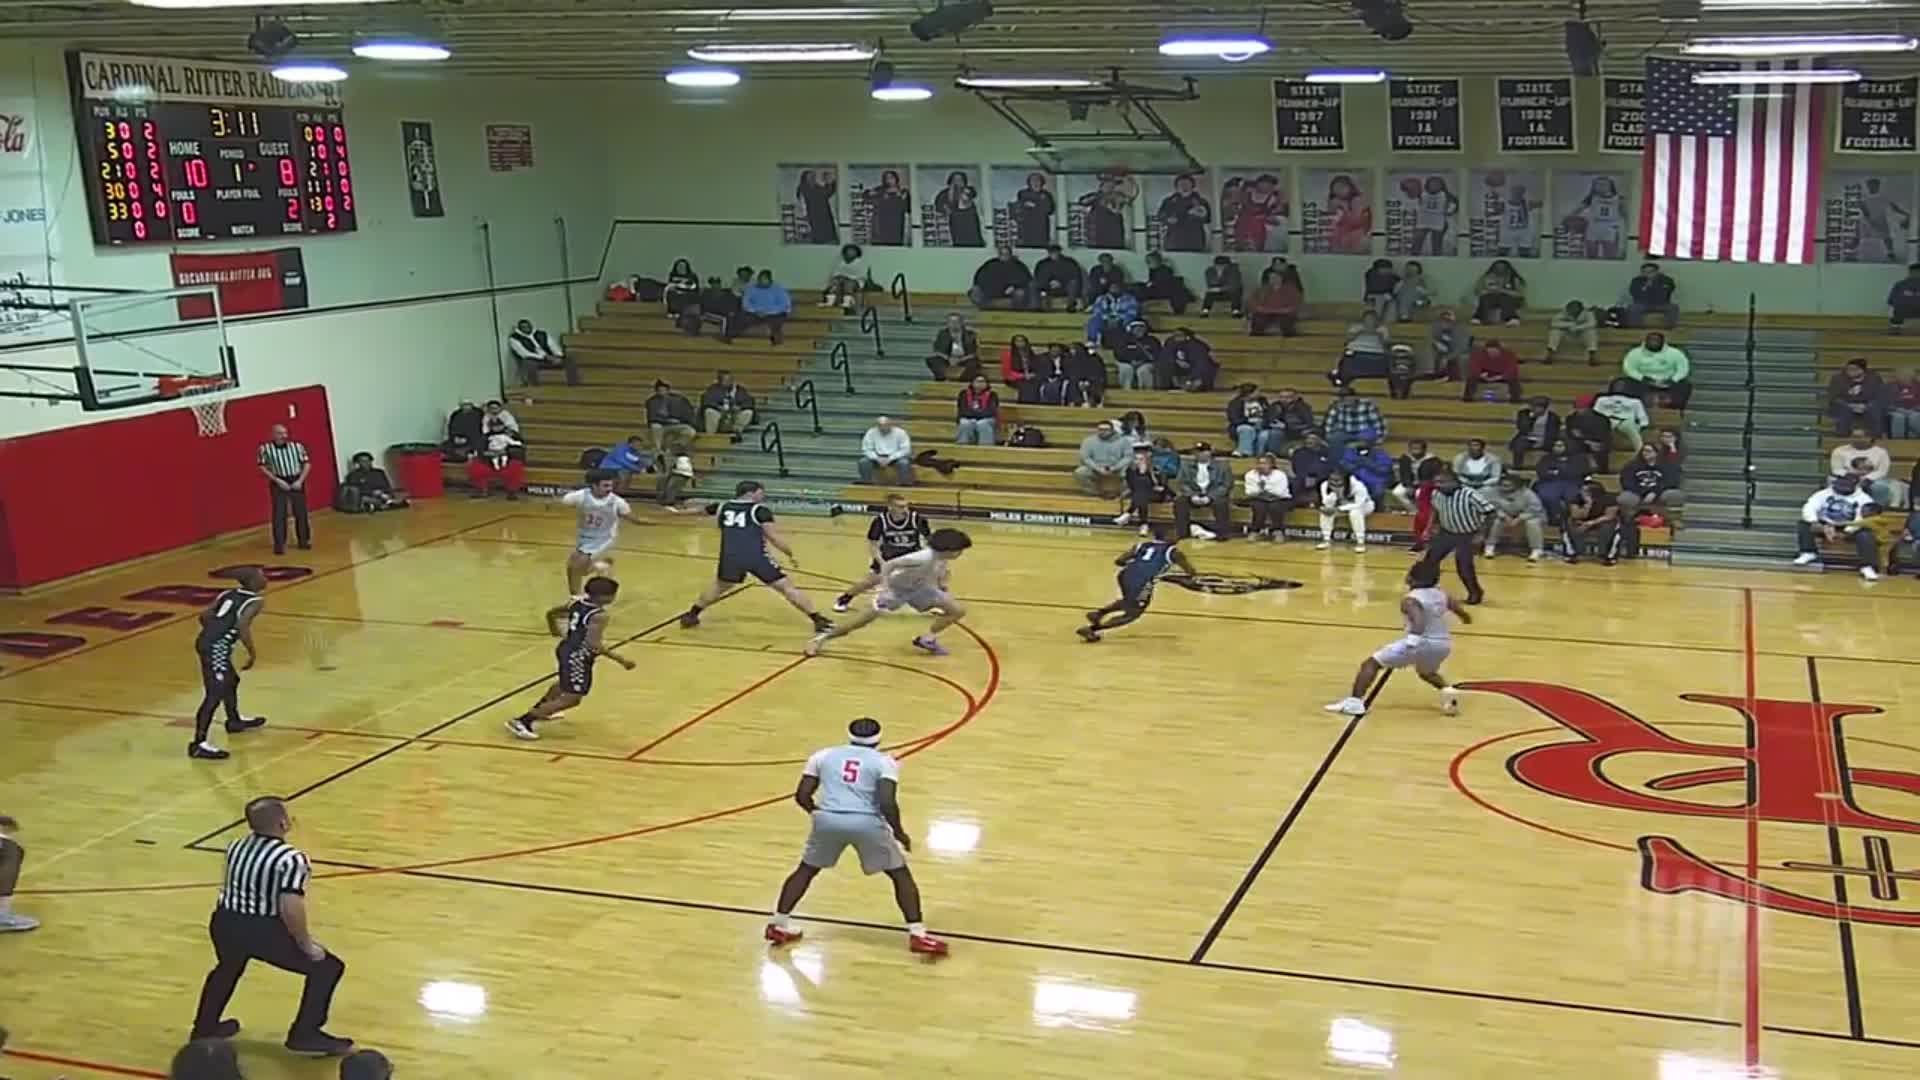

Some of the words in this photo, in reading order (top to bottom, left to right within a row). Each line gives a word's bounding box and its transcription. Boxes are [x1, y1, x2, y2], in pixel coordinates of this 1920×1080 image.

[85, 61, 182, 93] CARDINAL
[183, 67, 245, 96] RITTER
[1291, 85, 1327, 96] STATE
[1408, 84, 1441, 94] STATE
[1516, 83, 1553, 93] STATE
[1619, 83, 1644, 93] STA
[211, 108, 259, 136] 3:11
[1861, 111, 1898, 123] 2012
[105, 122, 116, 139] 3
[119, 122, 130, 139] 0
[144, 122, 154, 139] 2
[304, 126, 313, 142] 0
[315, 126, 325, 142] 0
[333, 127, 343, 142] 0
[1611, 122, 1645, 133] CLAS
[1869, 124, 1889, 135] 2A
[169, 141, 200, 155] HOME
[1283, 136, 1337, 146] FOOTBALL
[1398, 135, 1455, 146] FOOTBALL
[1506, 135, 1568, 146] FOOTBALL
[1845, 136, 1913, 148] FOOTBALL
[107, 142, 118, 159] 5
[122, 142, 133, 159] 0
[147, 142, 157, 159] 2
[317, 144, 328, 159] 0
[101, 162, 122, 179] 21
[125, 162, 136, 179] 0
[150, 162, 160, 179] 2
[185, 159, 208, 188] 10
[235, 163, 242, 182] 1
[280, 159, 294, 186] 8
[309, 161, 317, 177] 2
[338, 161, 347, 177] 0
[105, 182, 125, 200] 30
[128, 181, 139, 199] 0
[340, 178, 350, 194] 0
[108, 202, 128, 220] 33
[132, 201, 143, 219] 0
[155, 200, 166, 218] 0
[287, 198, 299, 219] 2
[324, 195, 333, 211] 0
[3, 208, 46, 223] JONES
[182, 201, 196, 225] 0
[327, 212, 336, 229] 2
[134, 220, 145, 239] 0
[724, 511, 746, 528] 34
[842, 759, 861, 784] 5
